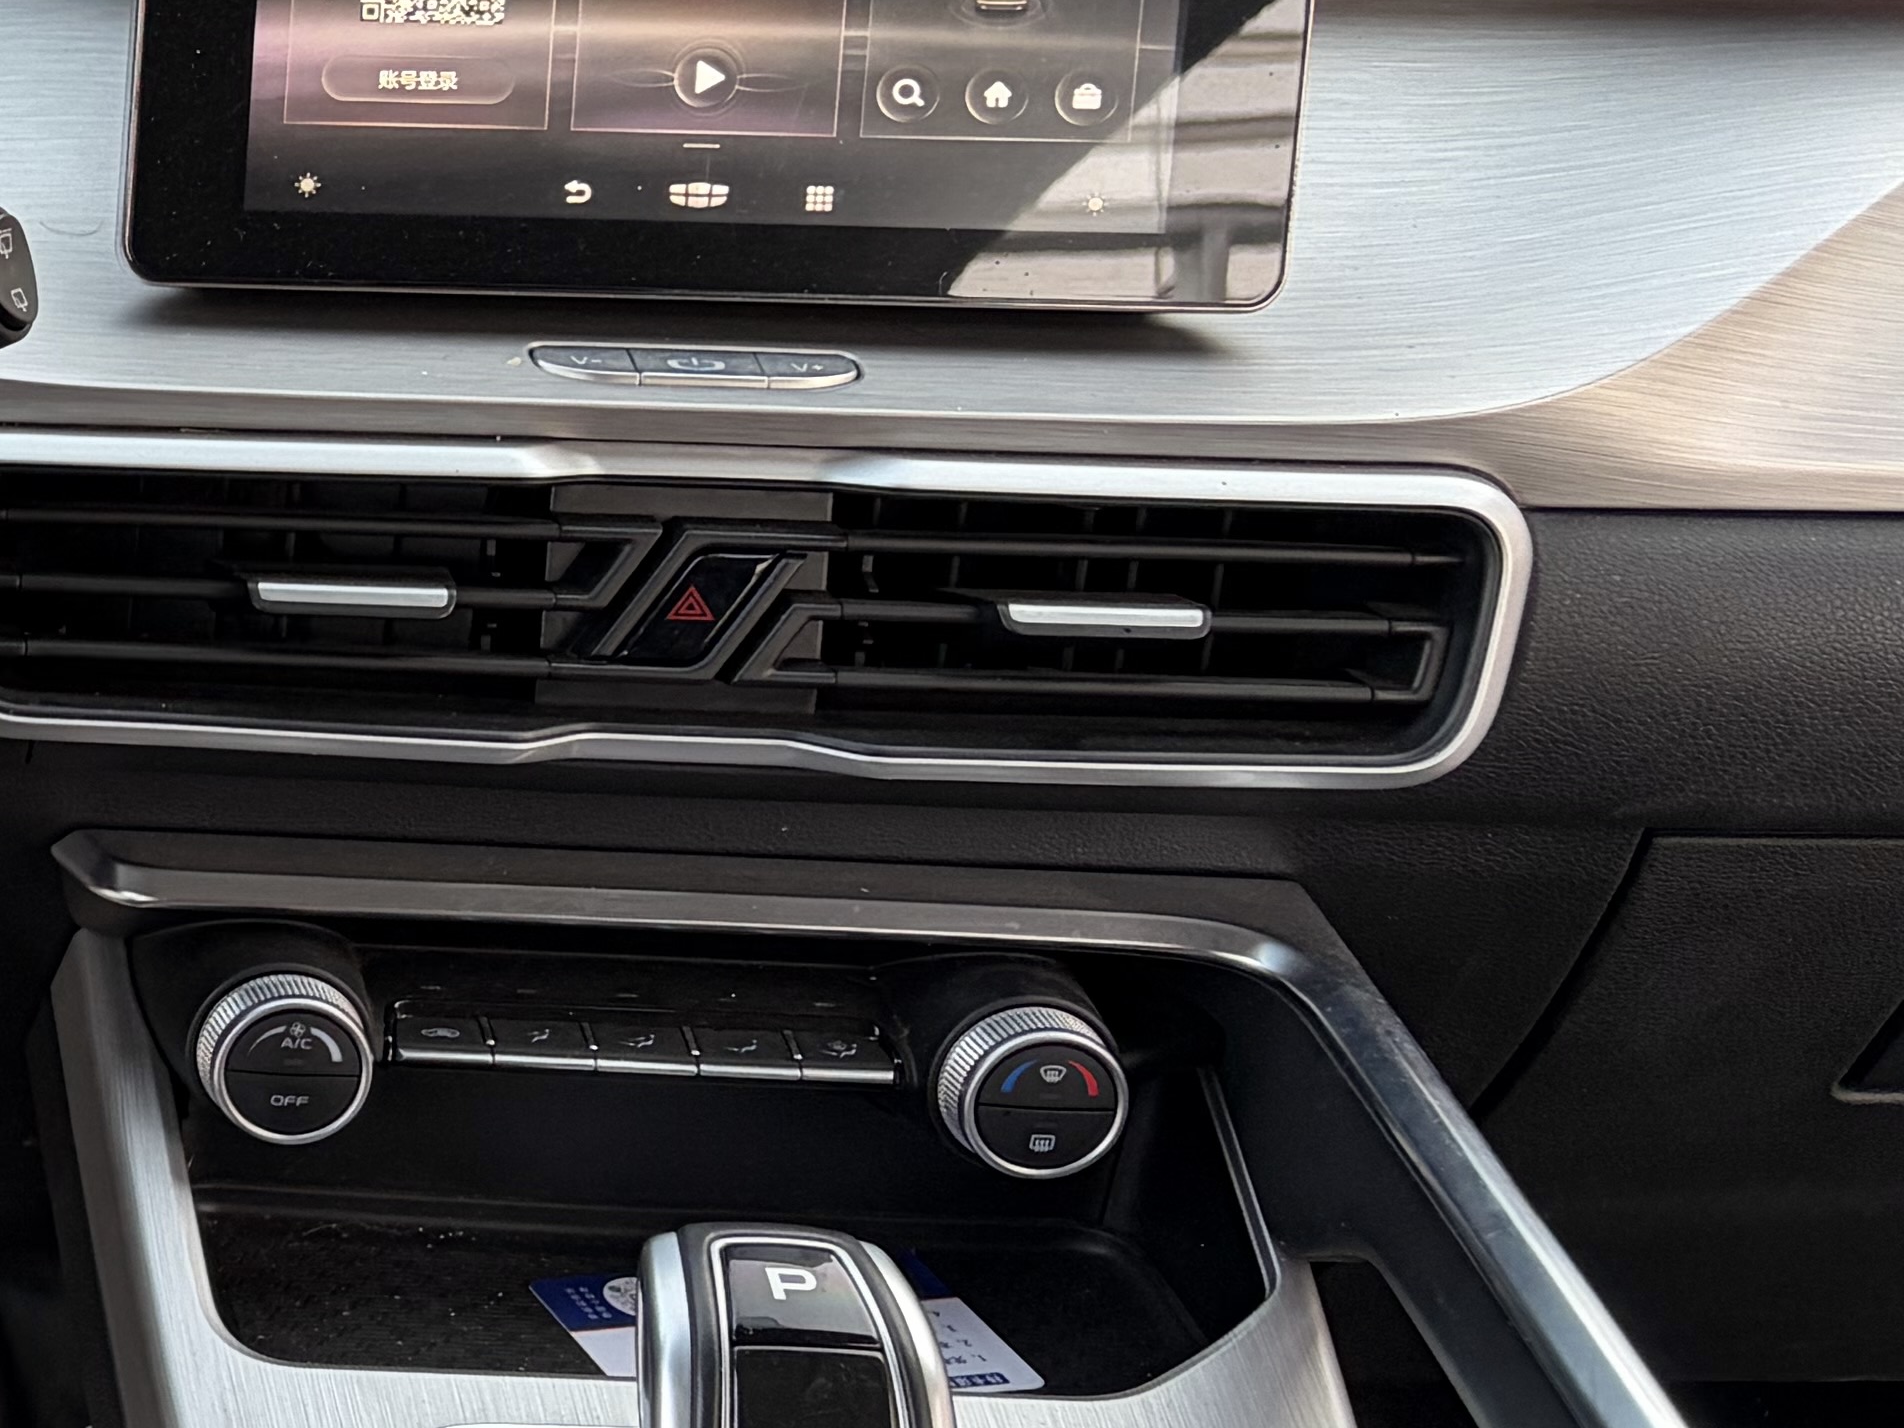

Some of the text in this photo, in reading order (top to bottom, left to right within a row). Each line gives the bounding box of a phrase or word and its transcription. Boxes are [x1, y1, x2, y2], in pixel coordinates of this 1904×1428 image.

[378, 70, 458, 90] 账号登录
[281, 1037, 312, 1049] A/C
[270, 1095, 309, 1106] OFF
[765, 1267, 817, 1300] P
